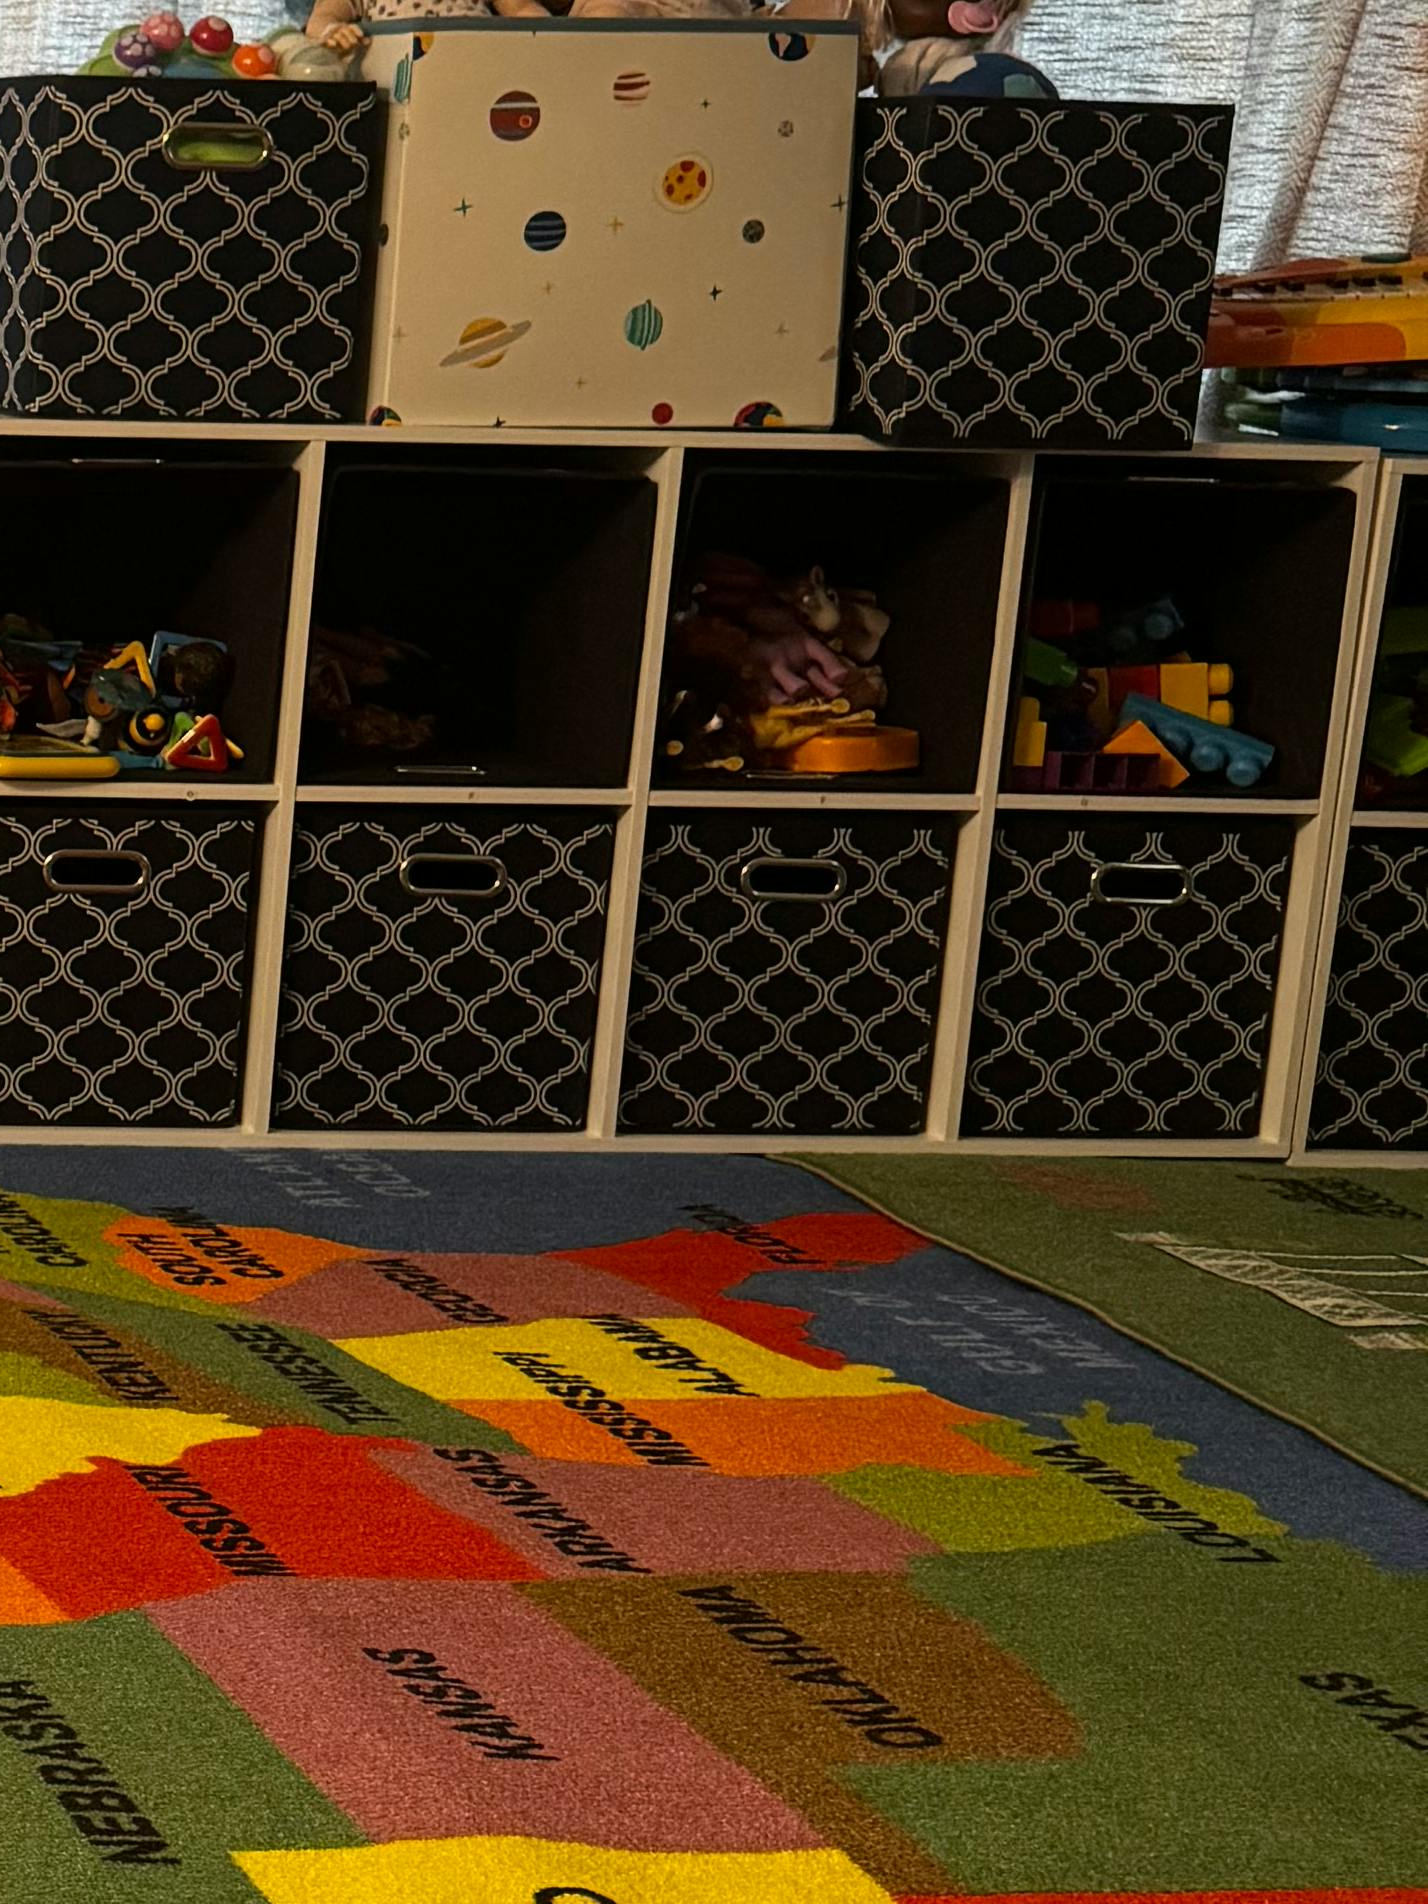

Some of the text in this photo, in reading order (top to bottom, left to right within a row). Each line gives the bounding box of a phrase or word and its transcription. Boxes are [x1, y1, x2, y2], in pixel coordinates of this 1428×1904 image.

[135, 1231, 226, 1288] SOUTH
[154, 1205, 283, 1281] CAROLINA
[683, 1202, 822, 1267] FLORIDA
[363, 1256, 510, 1325] GEORGIA
[935, 1292, 1138, 1370] MEXICO
[26, 1308, 181, 1404] KENTUCKY
[215, 1319, 404, 1426] TENNESSEE
[585, 1313, 762, 1397] ALABAMA
[893, 1313, 1049, 1376] GULF
[494, 1350, 711, 1469] MISSISSIPPI
[123, 1463, 294, 1579] MISSOURI
[432, 1445, 651, 1575] ARKANSAS
[1032, 1442, 1287, 1566] LOUISIANA
[363, 1644, 560, 1765] KANSAS
[678, 1583, 944, 1752] OKLAHOMA
